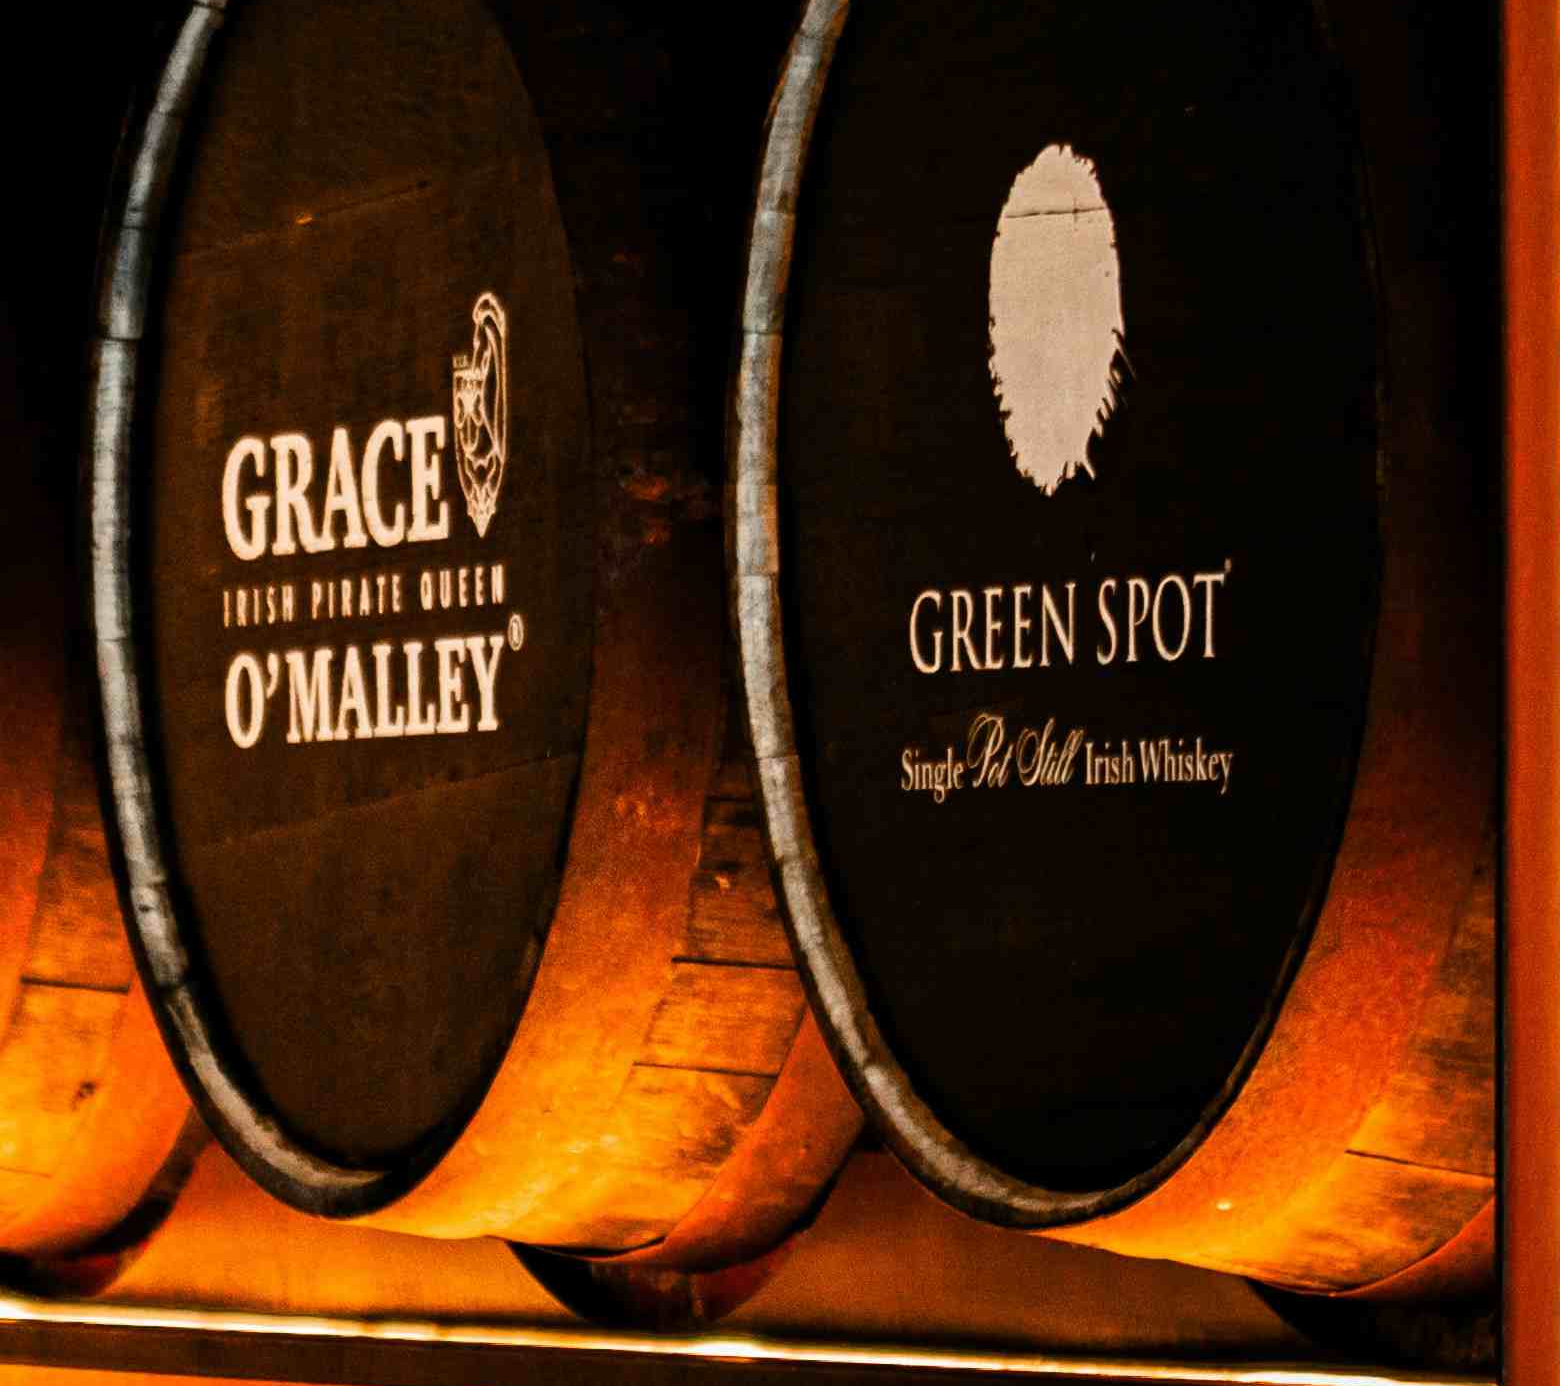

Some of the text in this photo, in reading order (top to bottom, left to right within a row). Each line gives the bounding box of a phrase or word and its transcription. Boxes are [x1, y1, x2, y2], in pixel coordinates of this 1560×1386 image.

[221, 415, 451, 561] GRACE
[223, 564, 506, 629] IRISH PIRATE QUEEN
[908, 572, 1227, 675] GREEN SPOT
[900, 712, 1235, 804] Single Pot Still Irish Whiskey
